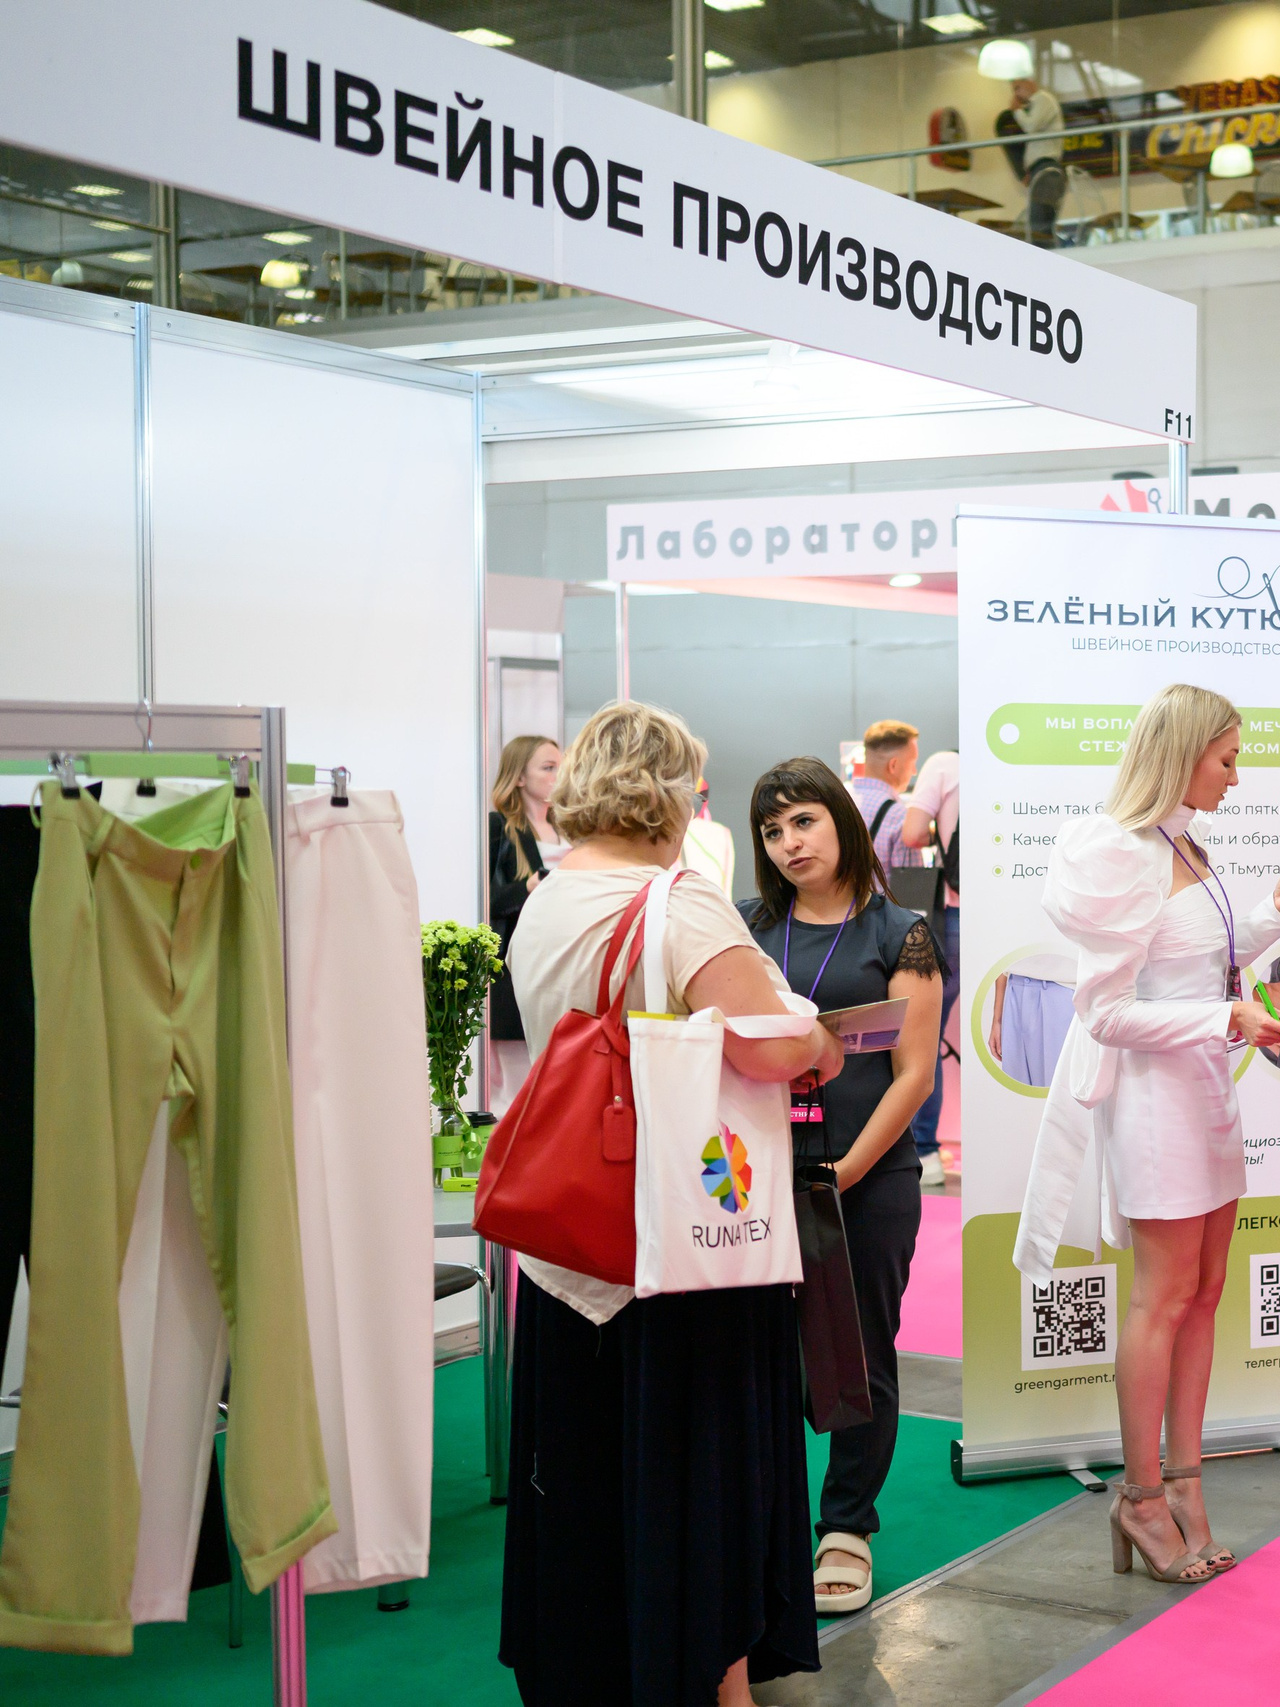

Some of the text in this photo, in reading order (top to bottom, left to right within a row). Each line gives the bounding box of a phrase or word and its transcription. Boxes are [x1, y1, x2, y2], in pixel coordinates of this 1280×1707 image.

[1178, 75, 1280, 111] VEGAS
[237, 37, 1082, 364] ШВЕЙНОЕ ПРОИЗВОДСТВО
[1164, 408, 1191, 438] F11
[616, 518, 957, 565] Лаборатор
[986, 596, 1176, 627] ЗЕЛЁНЫЙ
[1072, 636, 1153, 651] ШВЕЙНОЕ
[1045, 717, 1076, 729] МЫ
[1012, 802, 1060, 815] Шьем
[1064, 804, 1090, 815] так
[1228, 835, 1237, 845] и
[692, 1216, 772, 1248] RUNATEX
